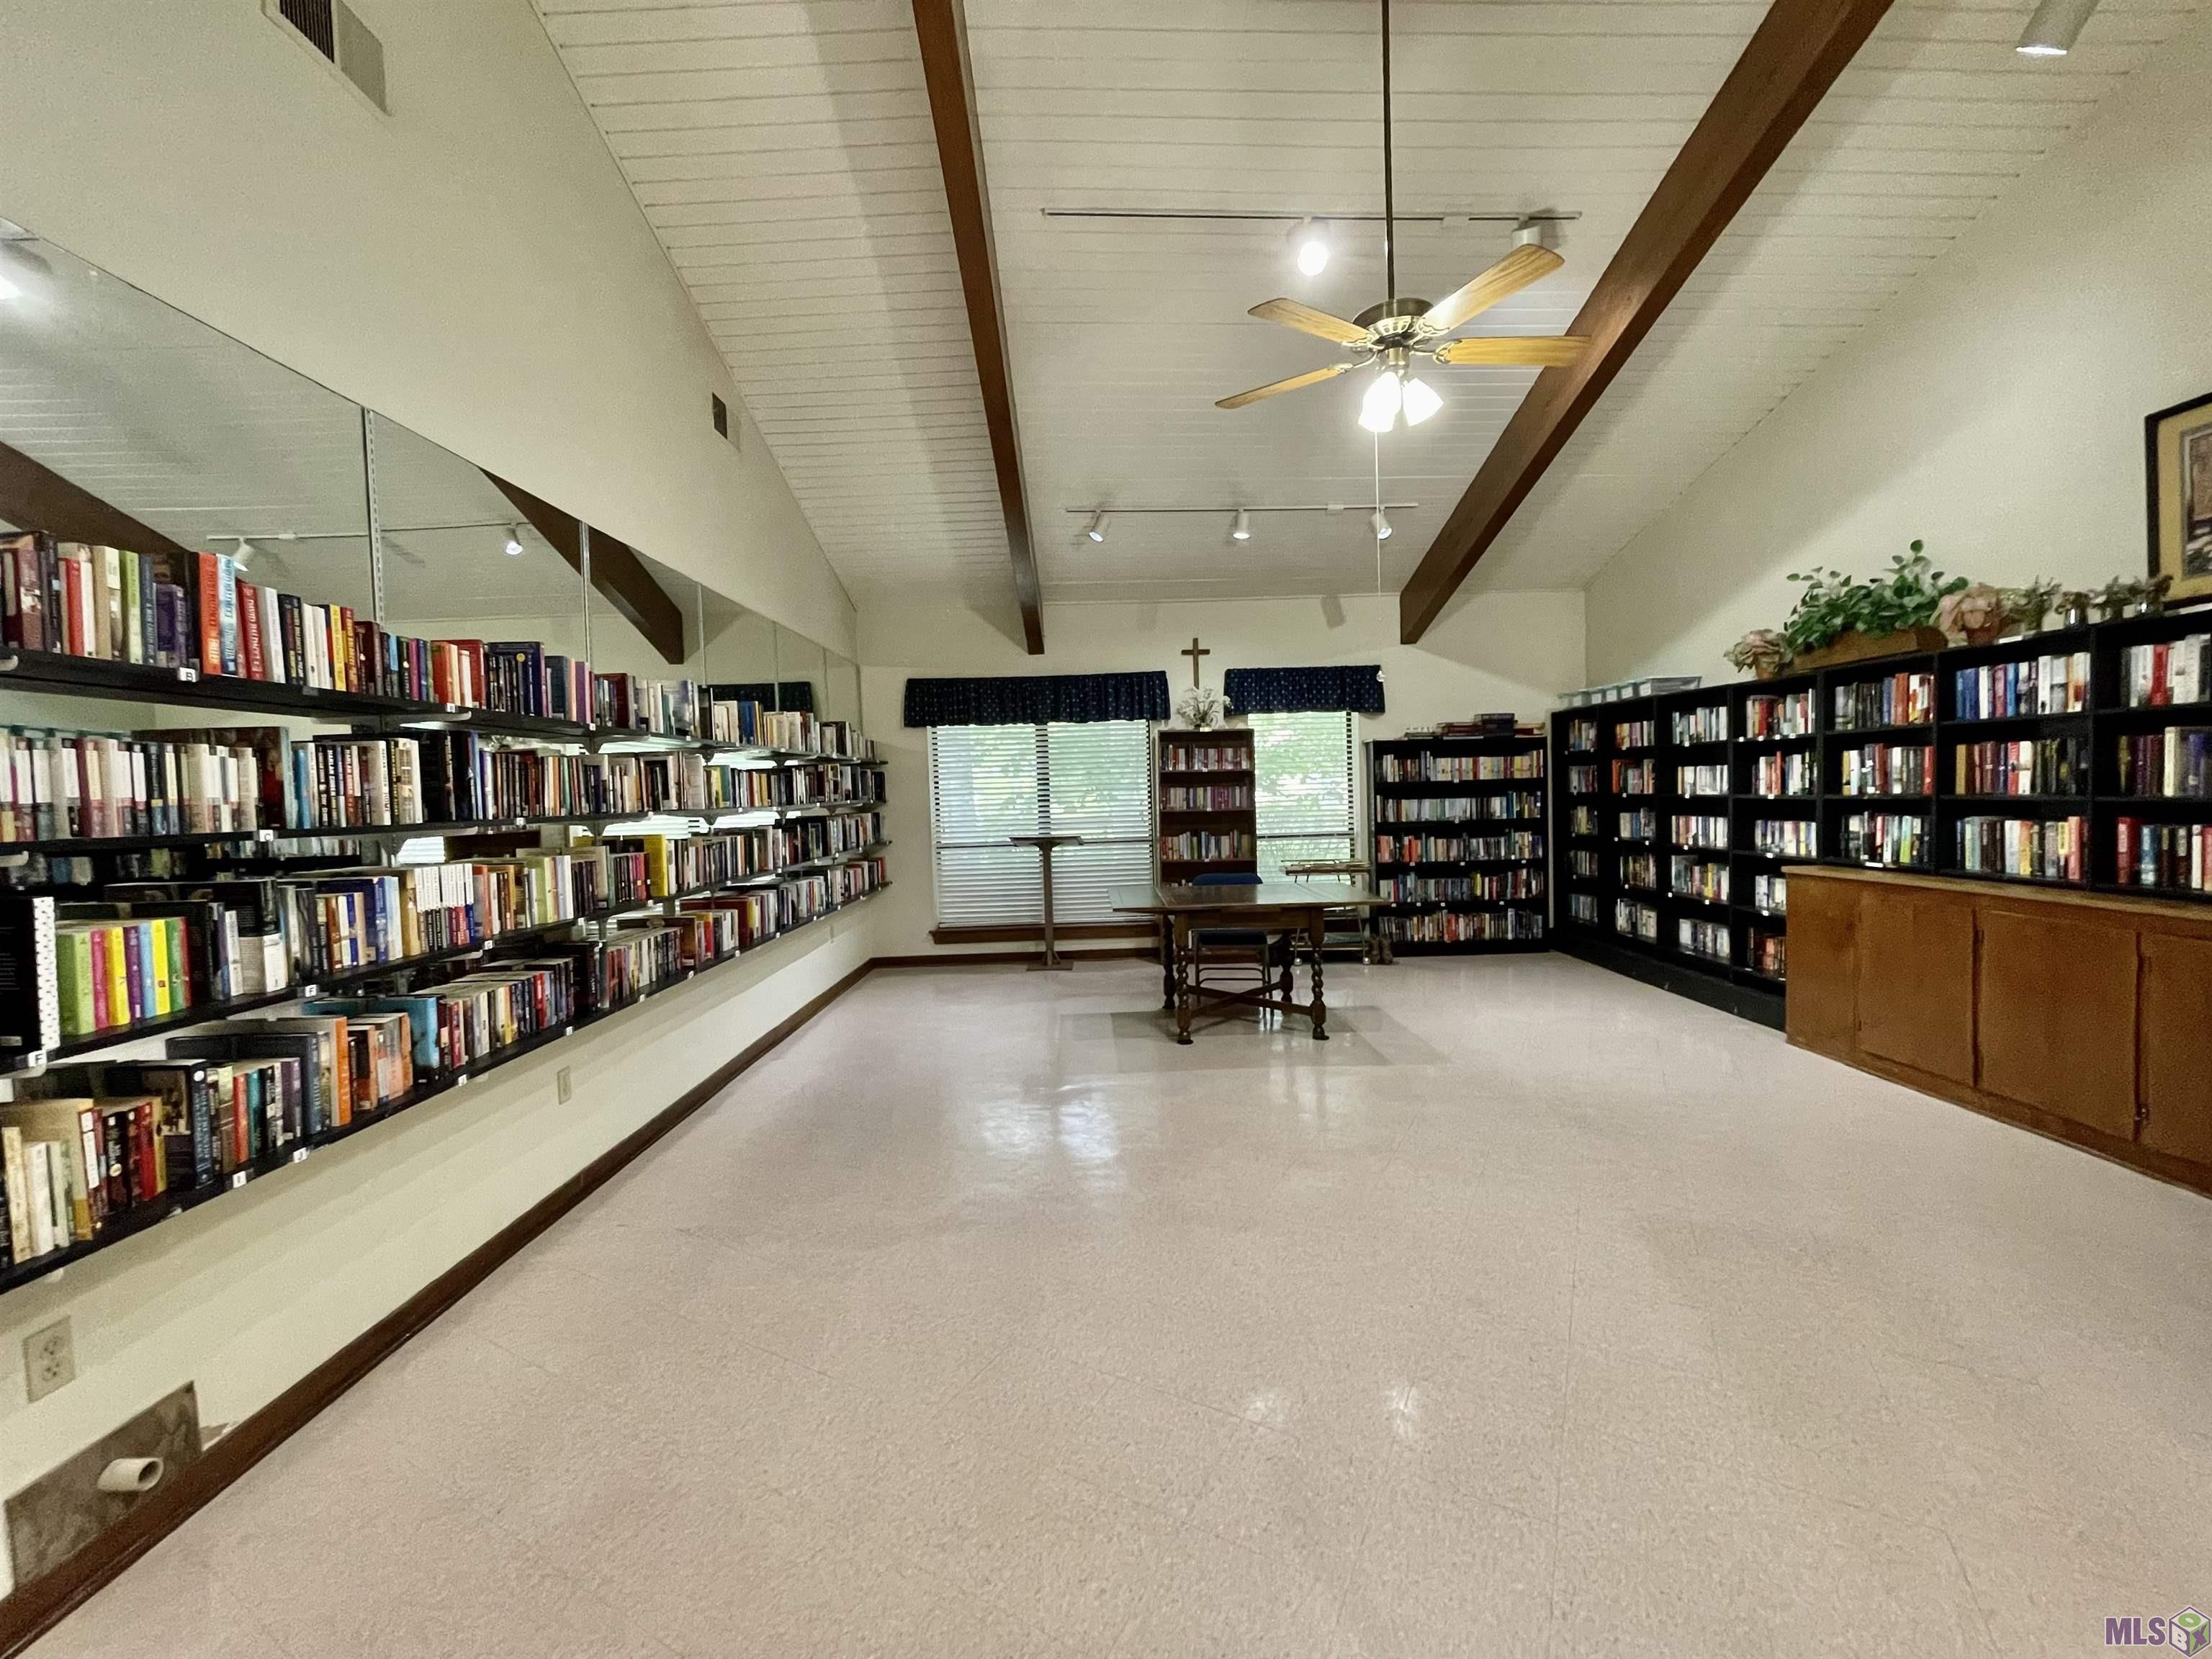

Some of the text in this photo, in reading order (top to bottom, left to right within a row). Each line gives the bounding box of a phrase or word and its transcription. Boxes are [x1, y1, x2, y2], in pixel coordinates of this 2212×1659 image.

[246, 599, 256, 622] DAVID
[249, 623, 260, 660] BALDACCI
[35, 1053, 43, 1065] F
